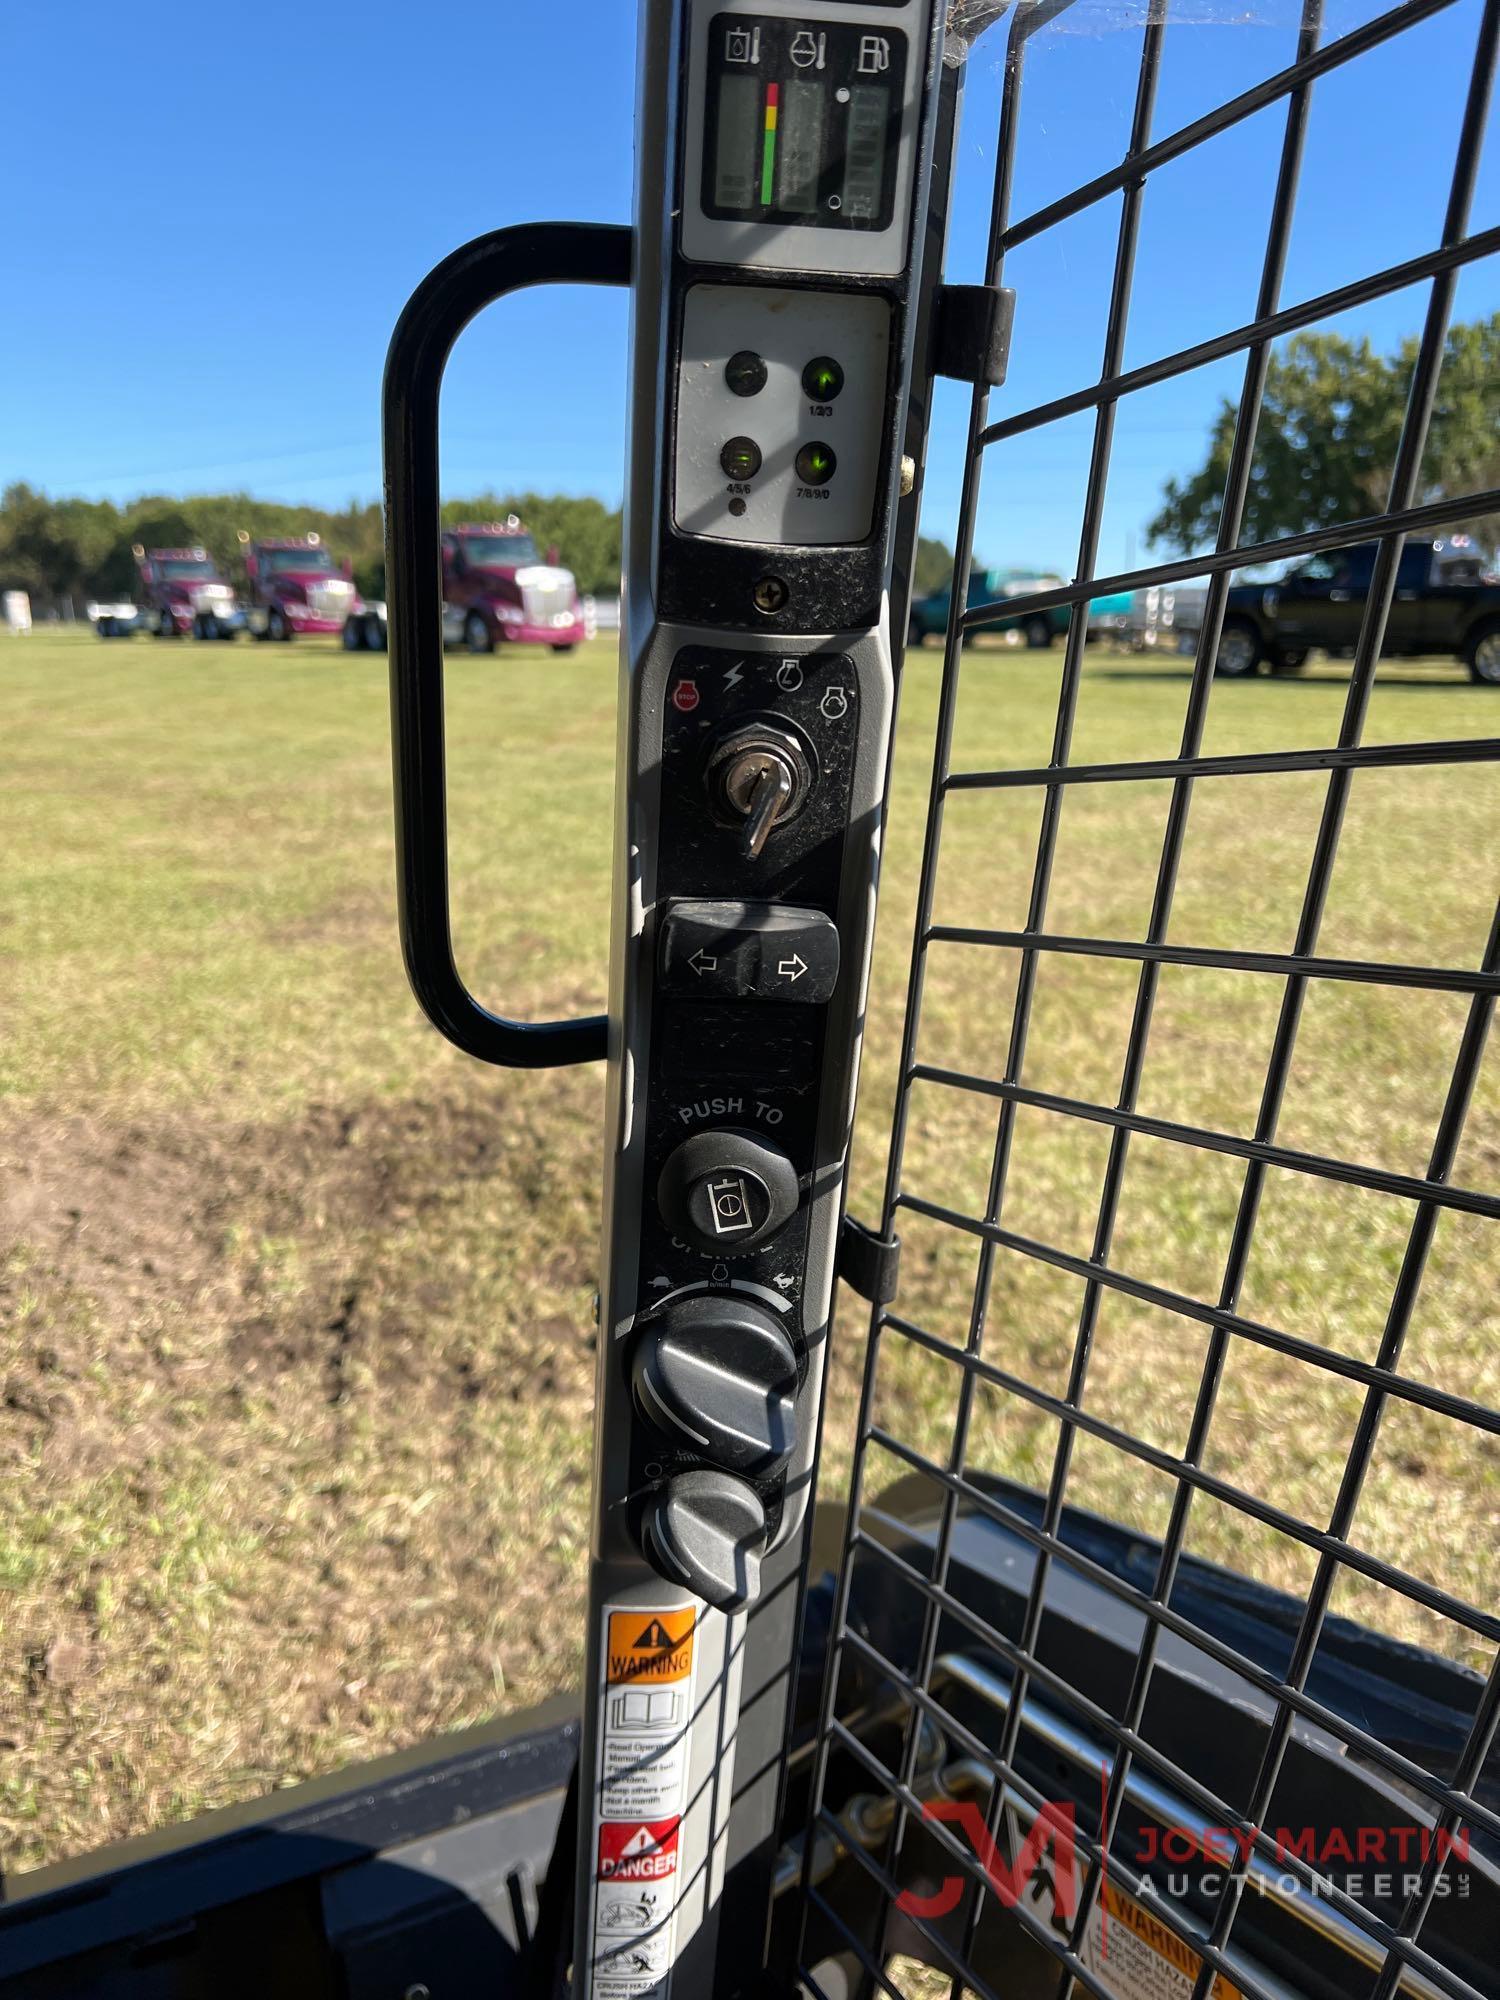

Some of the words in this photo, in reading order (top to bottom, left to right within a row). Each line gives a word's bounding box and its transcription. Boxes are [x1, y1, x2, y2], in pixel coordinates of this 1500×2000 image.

[809, 406, 833, 417] 1/2/3
[726, 484, 751, 494] 4/5/6
[679, 1097, 743, 1125] PUSH
[756, 1101, 784, 1124] TO
[611, 1651, 689, 1680] WARNING
[601, 1851, 676, 1877] DANGER
